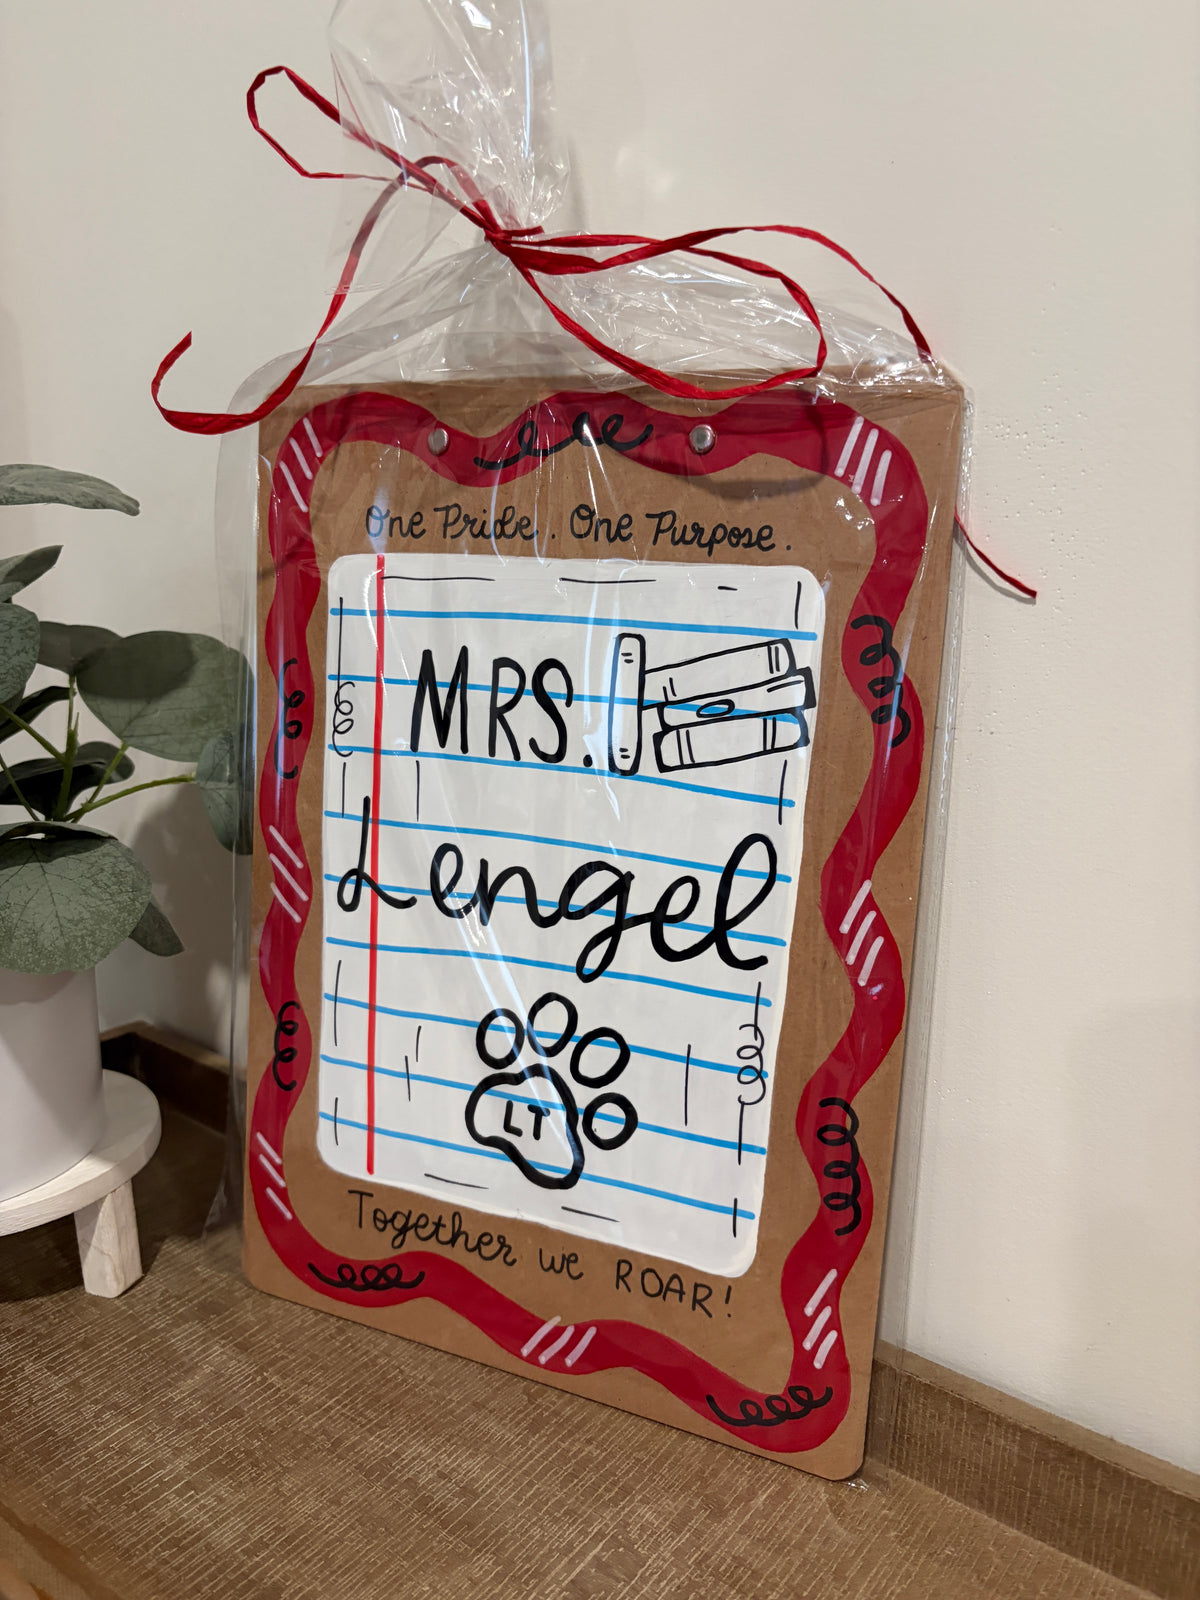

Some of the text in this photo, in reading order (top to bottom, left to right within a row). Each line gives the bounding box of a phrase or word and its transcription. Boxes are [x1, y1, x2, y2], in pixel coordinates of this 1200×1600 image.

[365, 503, 427, 540] One
[569, 503, 633, 543] One
[410, 645, 593, 767] MRS.
[337, 796, 778, 984] Lengel
[503, 1100, 551, 1140] LT
[347, 1189, 733, 1319] Together we ROAR!
